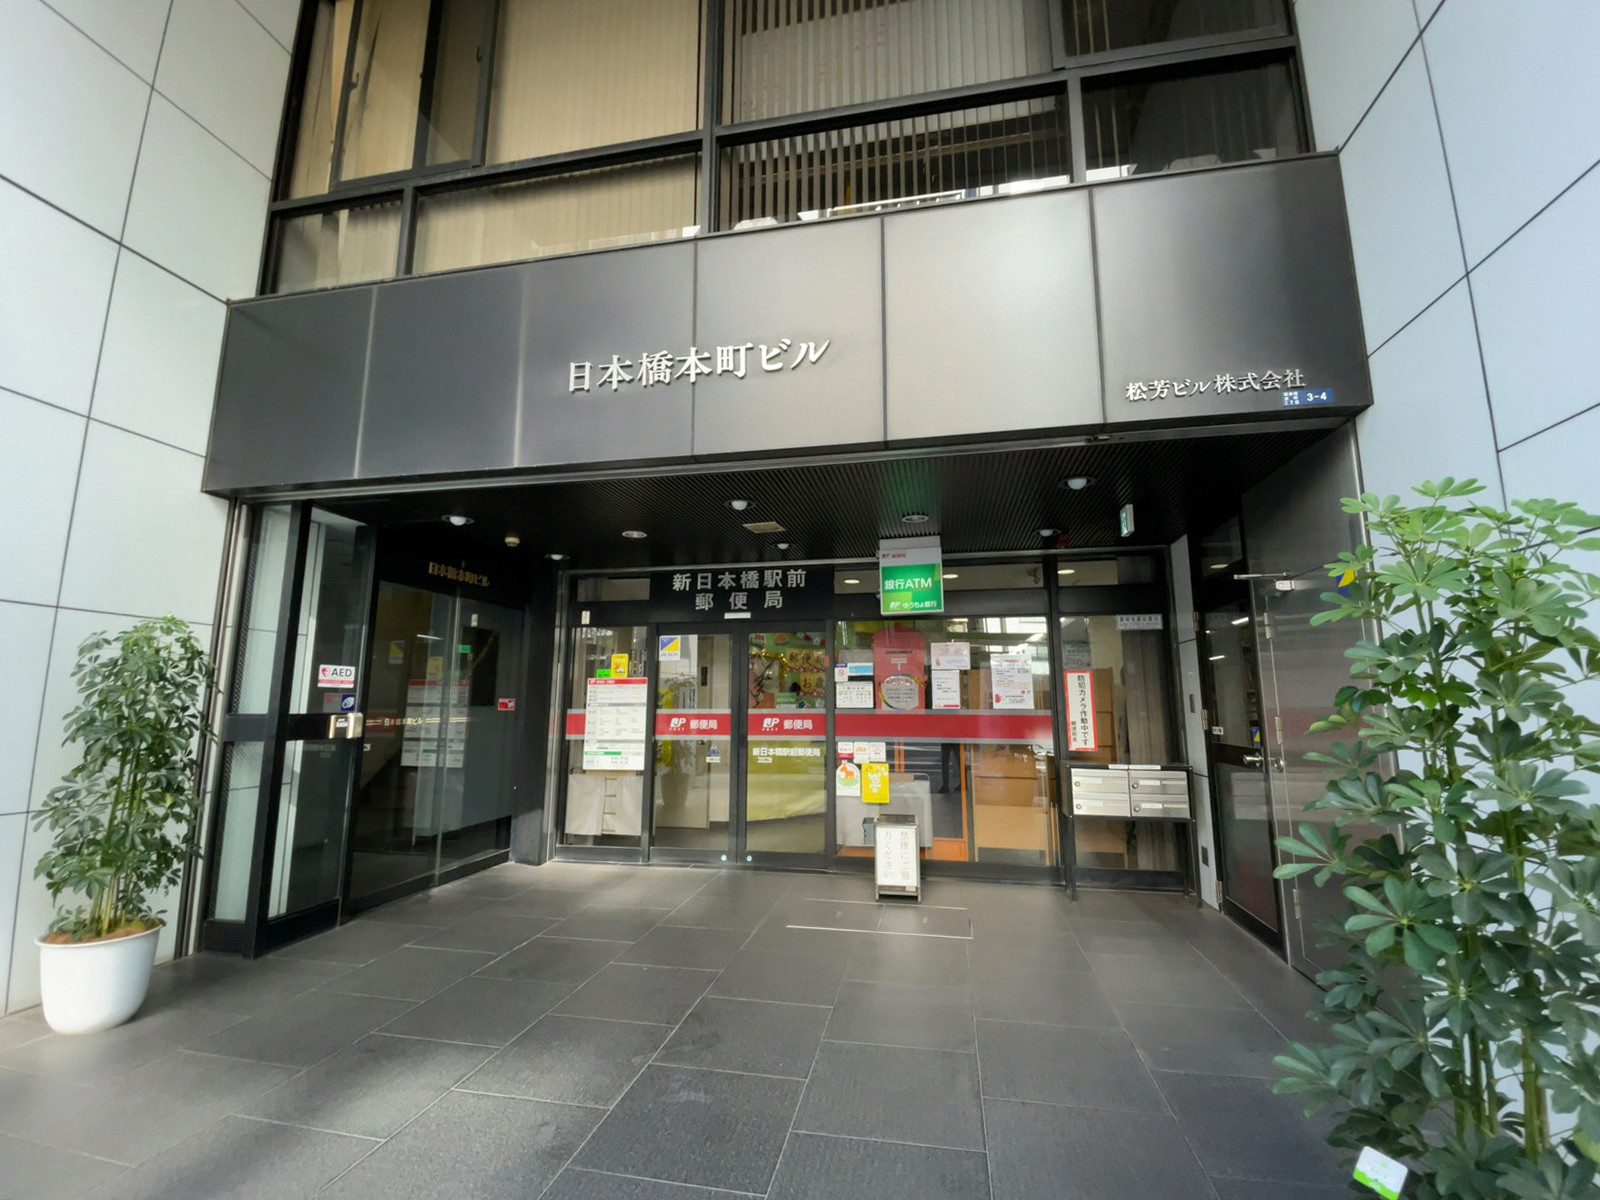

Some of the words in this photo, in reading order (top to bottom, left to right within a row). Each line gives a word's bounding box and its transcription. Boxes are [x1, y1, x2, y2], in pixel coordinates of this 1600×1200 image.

[568, 338, 831, 393] 日本橋本町ビル
[1125, 369, 1306, 400] 松芳ビル株式会社
[1306, 391, 1327, 401] 3-4
[672, 569, 807, 592] 新日本橋駅前
[884, 578, 932, 590] 銀行ATM
[695, 590, 783, 611] 郵便局
[331, 668, 353, 677] AED
[1077, 675, 1088, 746] 防犯カメラ作動中です
[689, 719, 718, 730] 郵便局
[783, 719, 813, 730] 郵便局
[752, 747, 821, 757] 新日本橋駅前郵便局
